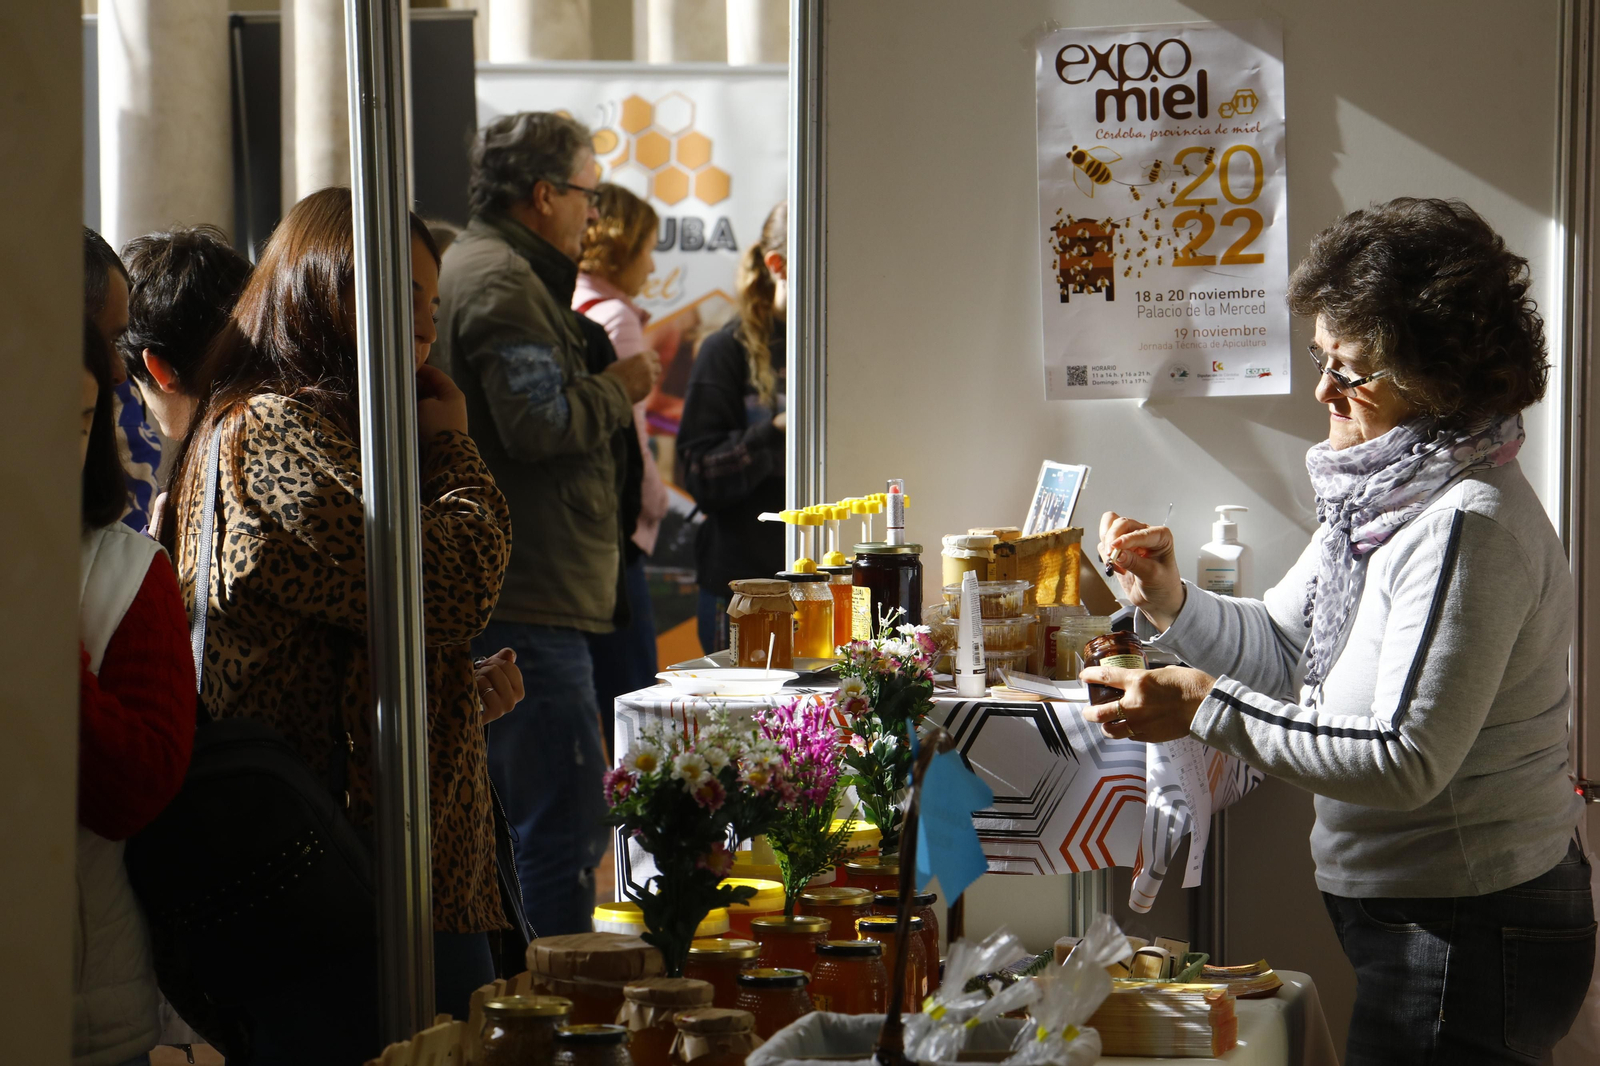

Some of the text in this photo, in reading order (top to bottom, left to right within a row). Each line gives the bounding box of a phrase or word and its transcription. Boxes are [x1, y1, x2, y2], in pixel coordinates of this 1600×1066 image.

[1055, 38, 1192, 90] expo
[1095, 69, 1208, 123] miel
[1150, 125, 1211, 141] provincia
[1214, 123, 1229, 134] de
[1231, 121, 1262, 134] miel
[1173, 144, 1264, 207] 20
[1171, 207, 1265, 267] 22
[1135, 287, 1266, 302] 18 a 20 noviembre
[1137, 301, 1266, 319] Palacio de la Merced
[1174, 325, 1267, 340] 19 noviembre
[1138, 338, 1267, 351] Jornada Técnica de Apicultura
